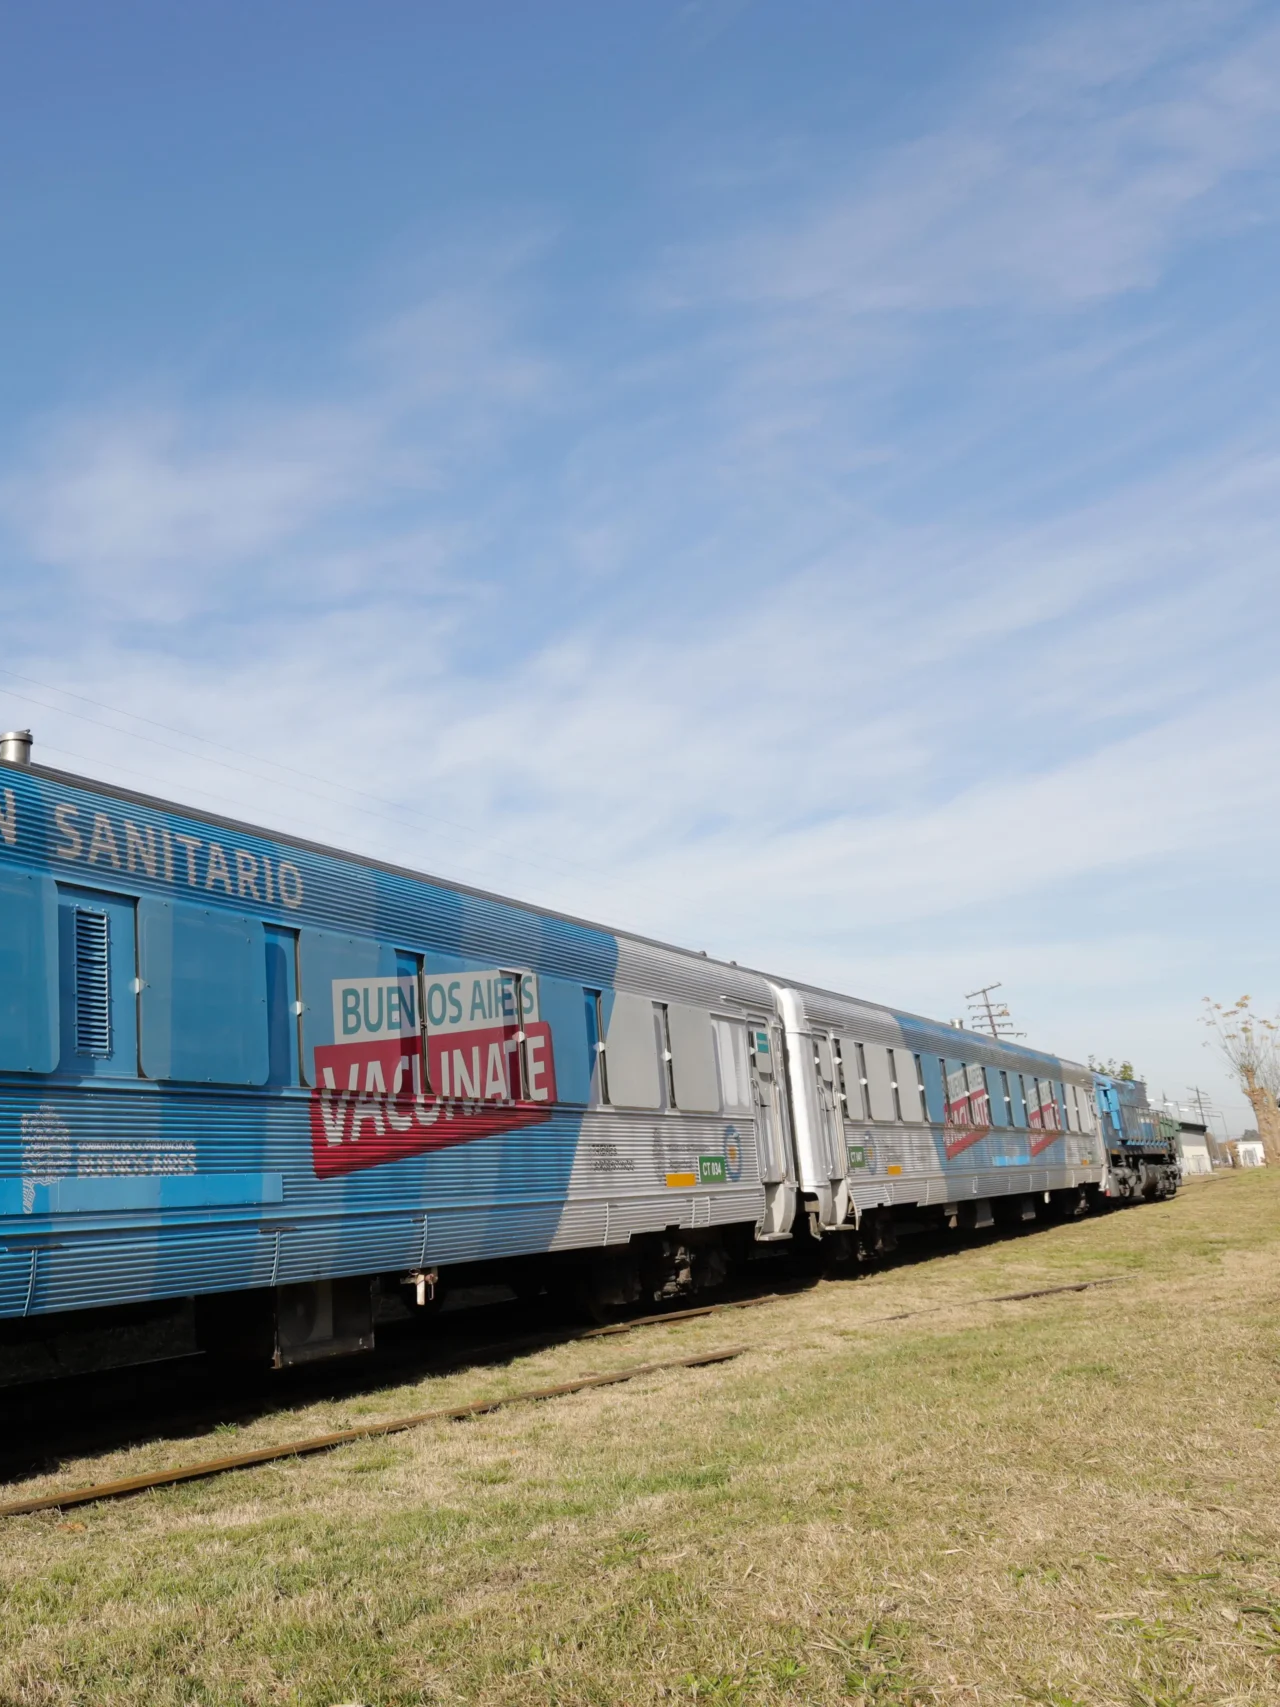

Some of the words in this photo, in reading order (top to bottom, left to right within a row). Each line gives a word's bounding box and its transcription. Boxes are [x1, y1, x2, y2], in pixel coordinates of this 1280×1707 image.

[54, 802, 305, 910] SANITARIO
[341, 980, 463, 1036] BUENOS
[470, 974, 535, 1022] AIRES
[320, 1035, 549, 1148] VACUNATE
[702, 1162, 712, 1176] CT
